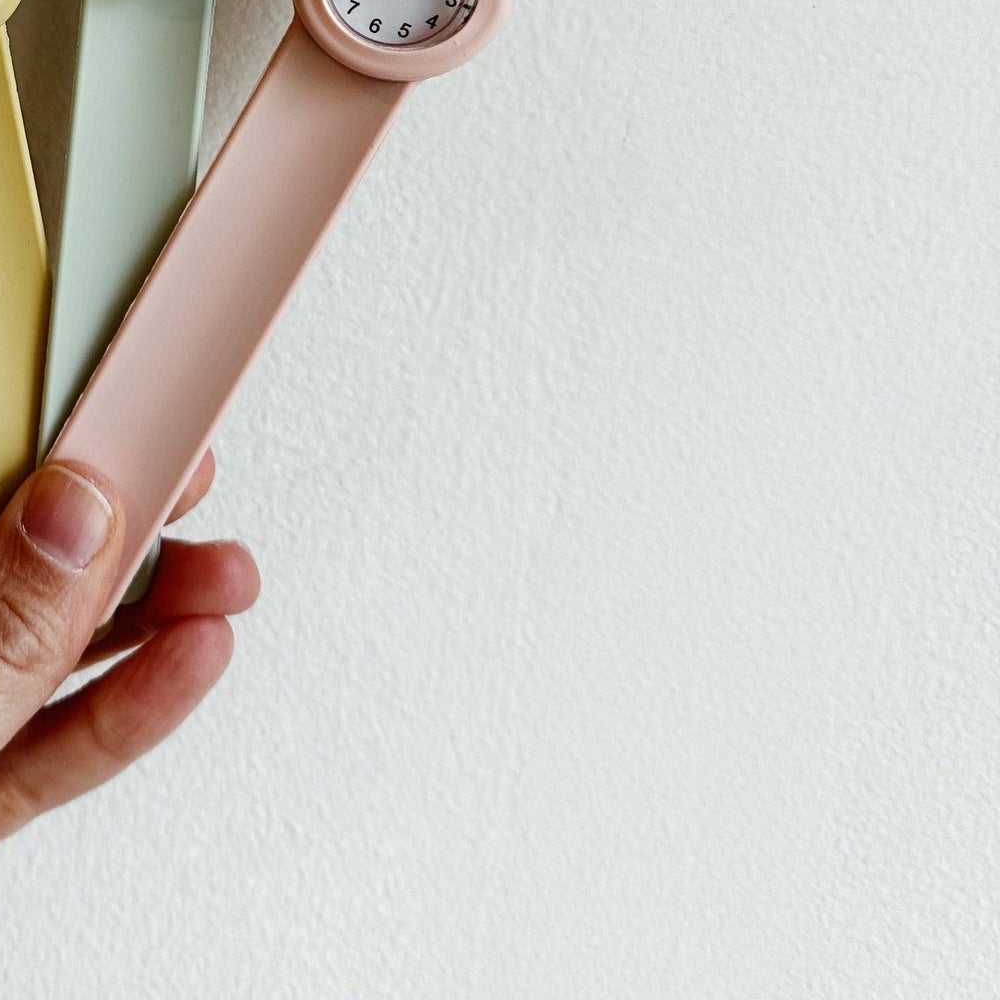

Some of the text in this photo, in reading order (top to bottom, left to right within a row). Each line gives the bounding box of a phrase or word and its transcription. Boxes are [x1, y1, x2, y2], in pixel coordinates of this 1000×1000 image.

[347, 0, 360, 14] 7
[369, 18, 382, 33] 6
[426, 15, 439, 29] 4
[398, 23, 412, 38] 5
